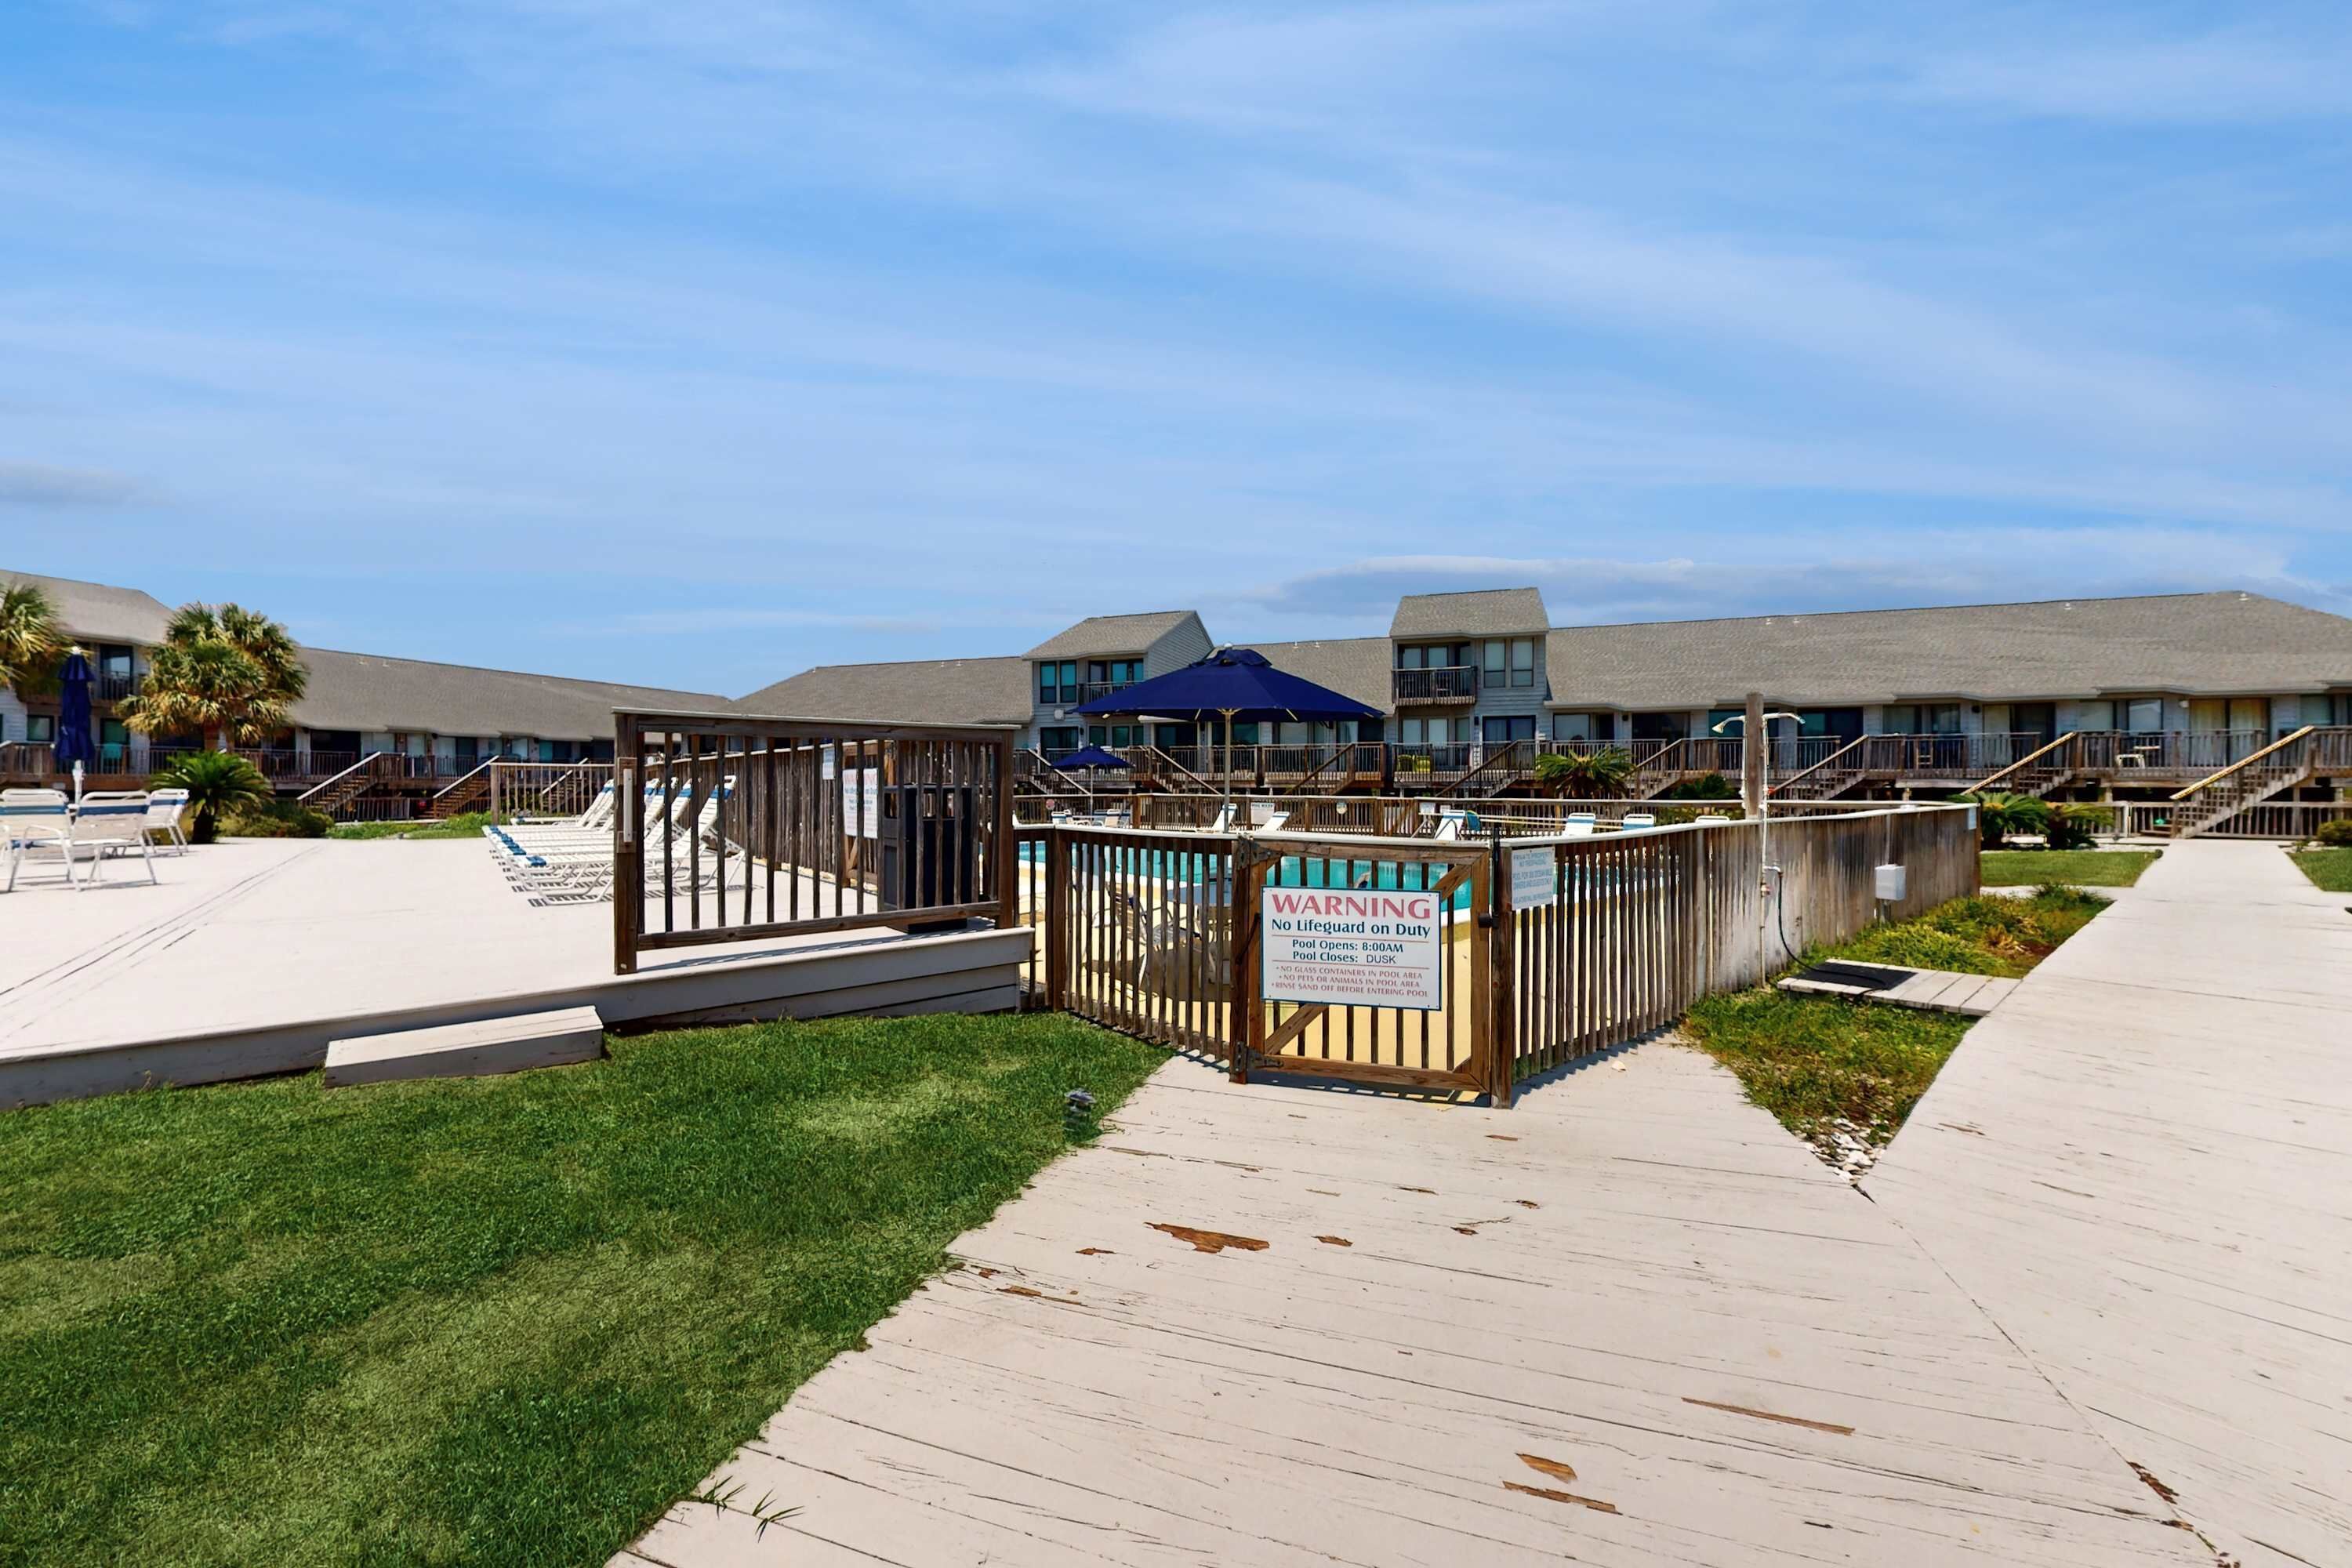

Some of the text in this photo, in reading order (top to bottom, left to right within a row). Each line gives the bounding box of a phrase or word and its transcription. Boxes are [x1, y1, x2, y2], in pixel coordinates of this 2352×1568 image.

[1272, 895, 1431, 919] WARNING
[1272, 919, 1431, 938] No Lifeguard on Duty
[1292, 939, 1403, 953] Pool Opens: 8:00AM
[1293, 951, 1396, 964] Pool Closes: DUSK
[1319, 967, 1366, 976] CONTAINERS
[1330, 976, 1363, 985] ANIMALS
[1367, 987, 1404, 996] ENTERING
